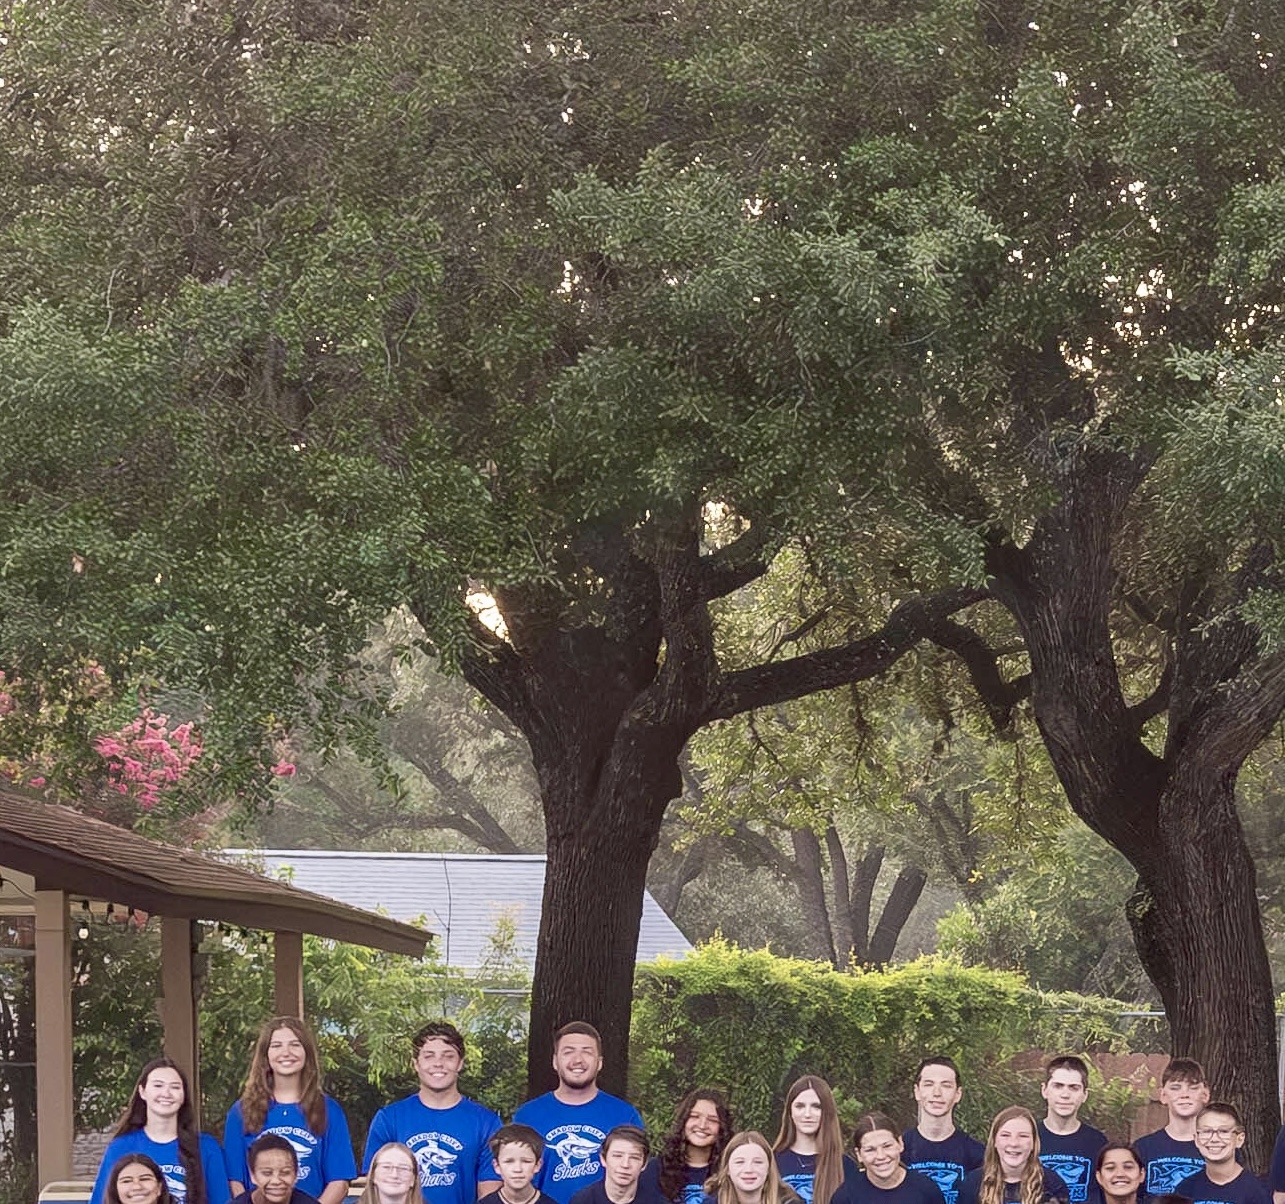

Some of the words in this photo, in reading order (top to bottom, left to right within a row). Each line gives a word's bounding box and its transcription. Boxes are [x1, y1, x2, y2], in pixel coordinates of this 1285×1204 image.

[546, 1124, 581, 1140] SHADOW
[582, 1126, 606, 1141] CLIFF
[406, 1132, 439, 1150] SHADOW
[440, 1134, 463, 1150] CLIFF
[1039, 1154, 1074, 1162] WELCOME
[1158, 1157, 1194, 1165] WELCOME
[553, 1159, 600, 1181] Sharks
[912, 1162, 944, 1170] WELCOME
[946, 1162, 957, 1170] TO
